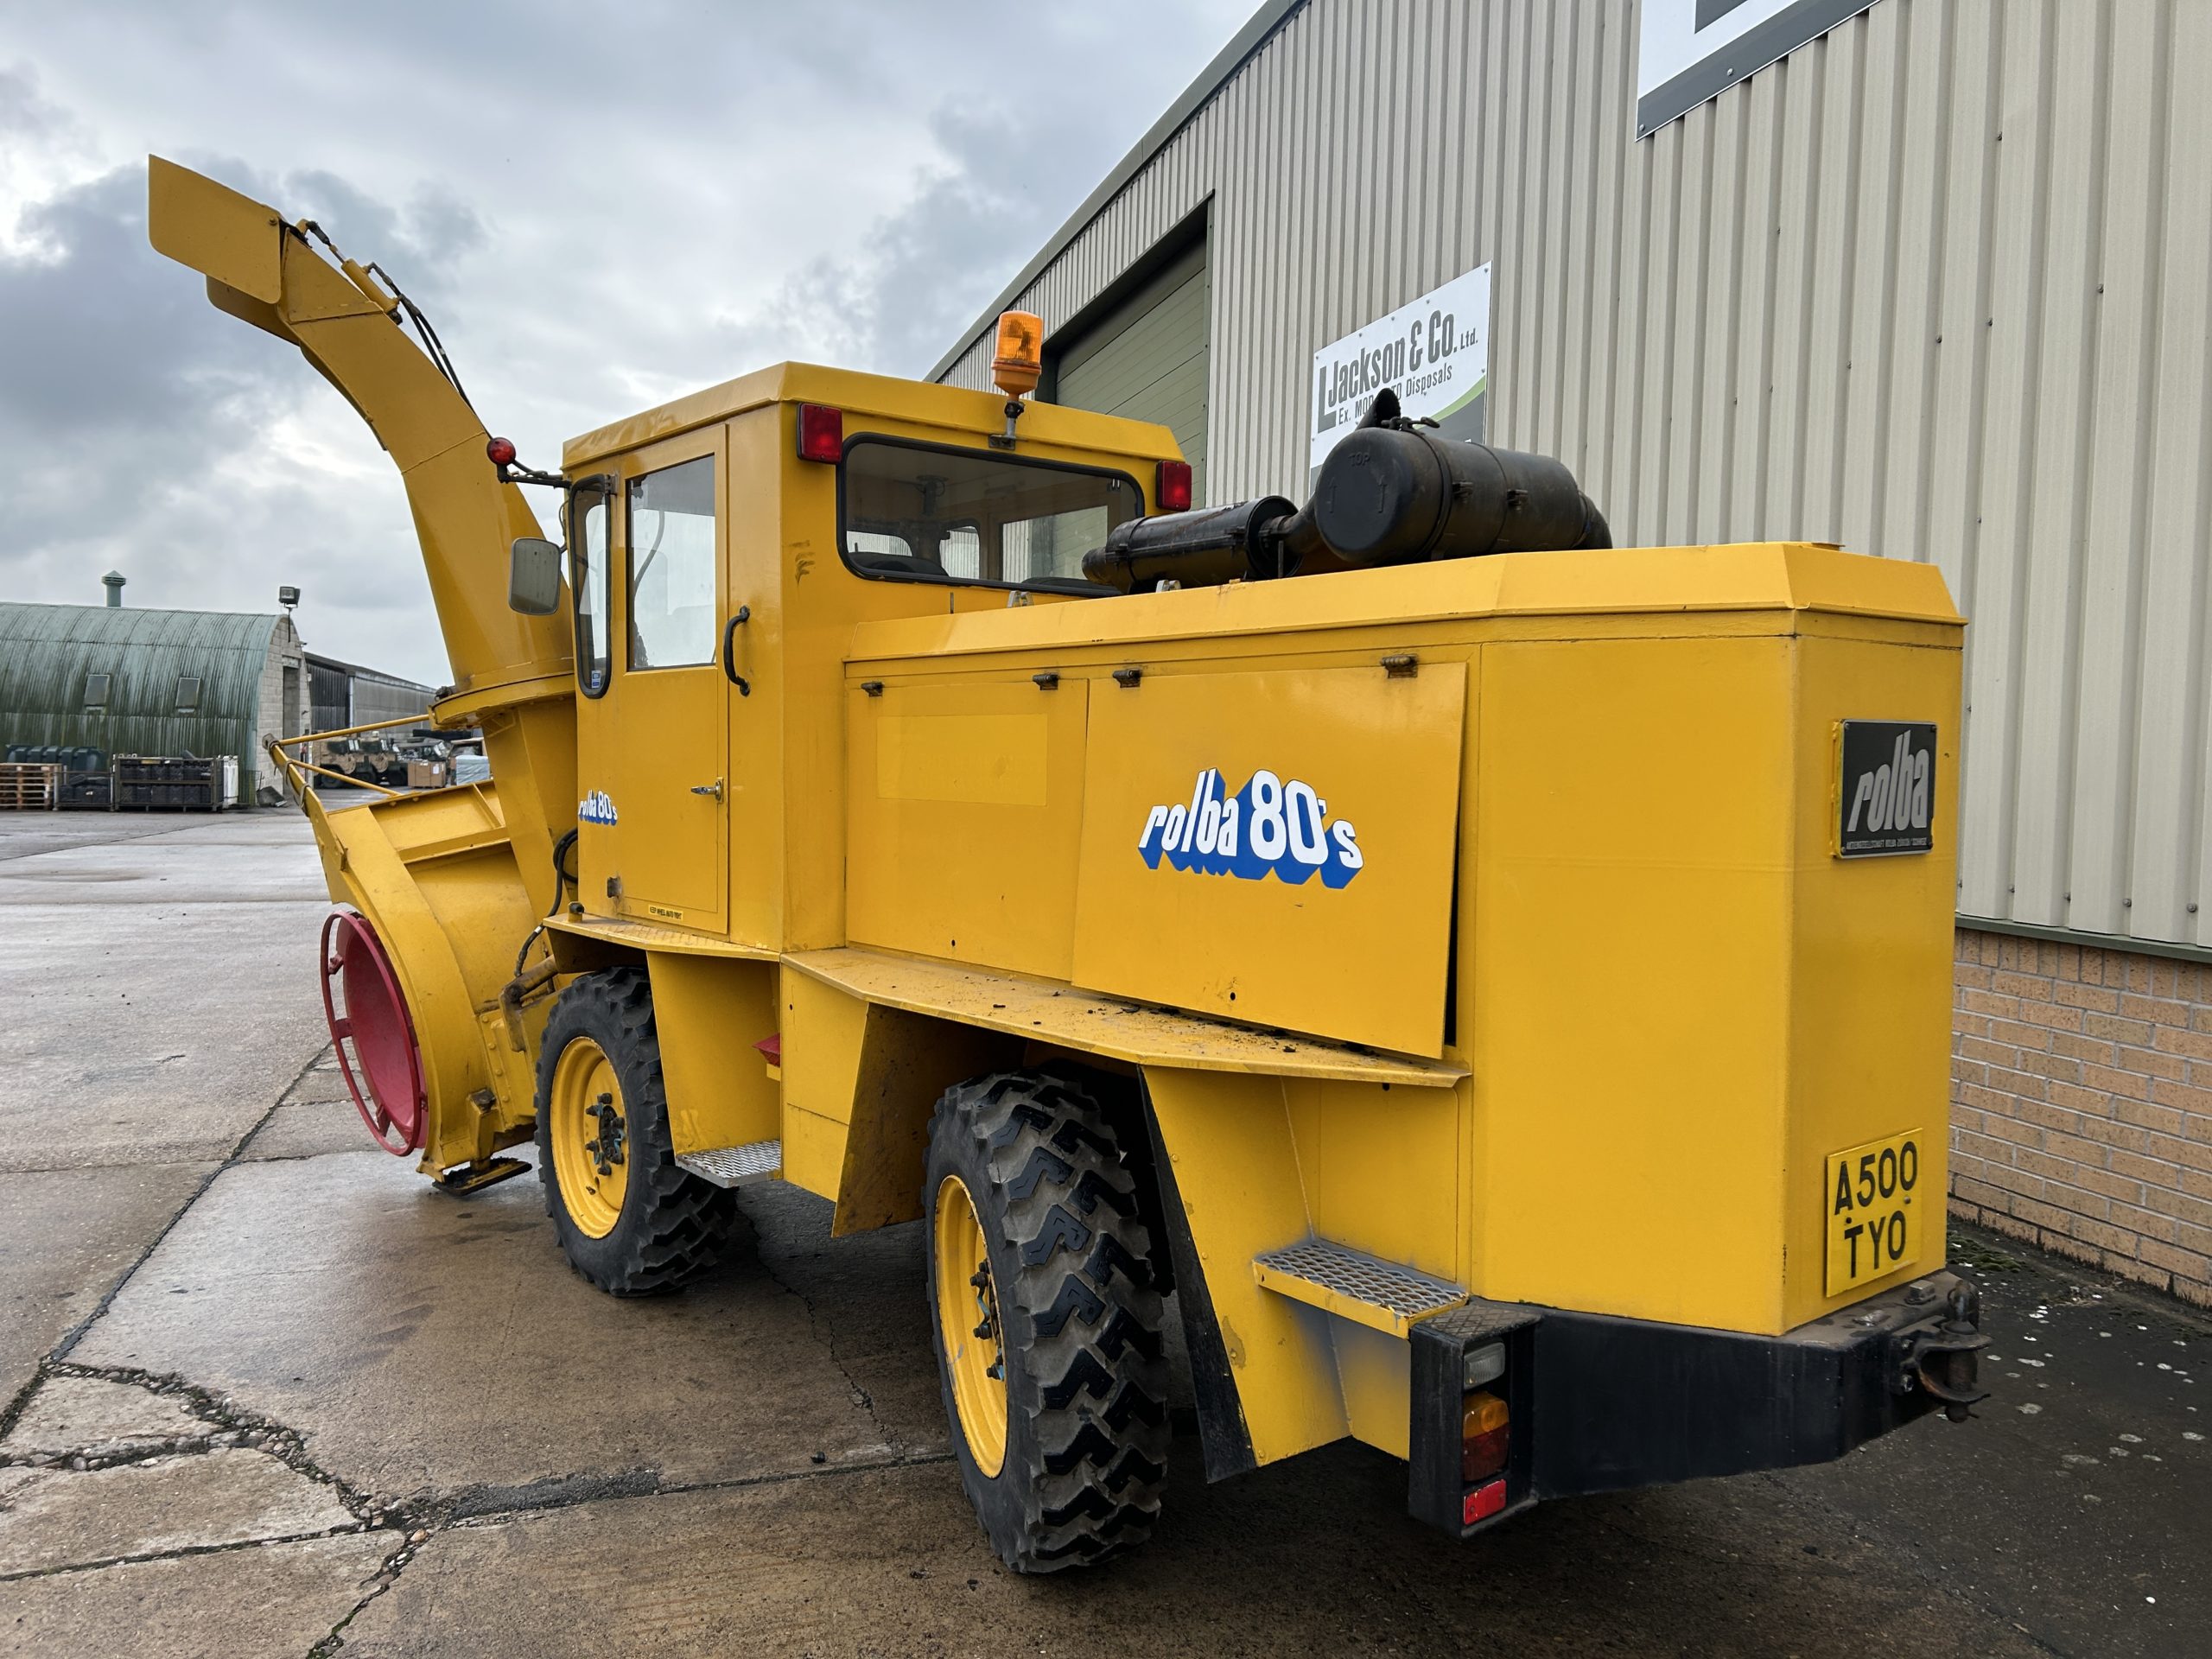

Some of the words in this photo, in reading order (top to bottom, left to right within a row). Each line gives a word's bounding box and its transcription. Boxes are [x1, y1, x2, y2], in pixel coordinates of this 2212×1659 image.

[1409, 320, 1423, 372] &
[1428, 309, 1458, 364] Co.
[1460, 328, 1478, 350] Ltd.
[1338, 407, 1351, 425] Ex.
[1406, 362, 1452, 397] Disposals
[1347, 451, 1370, 467] TOP
[1847, 729, 1929, 833] rolba
[1137, 767, 1240, 859] rolba
[1249, 769, 1364, 871] 80's
[1834, 1141, 1918, 1216] A500
[1844, 1210, 1906, 1279] TYO
